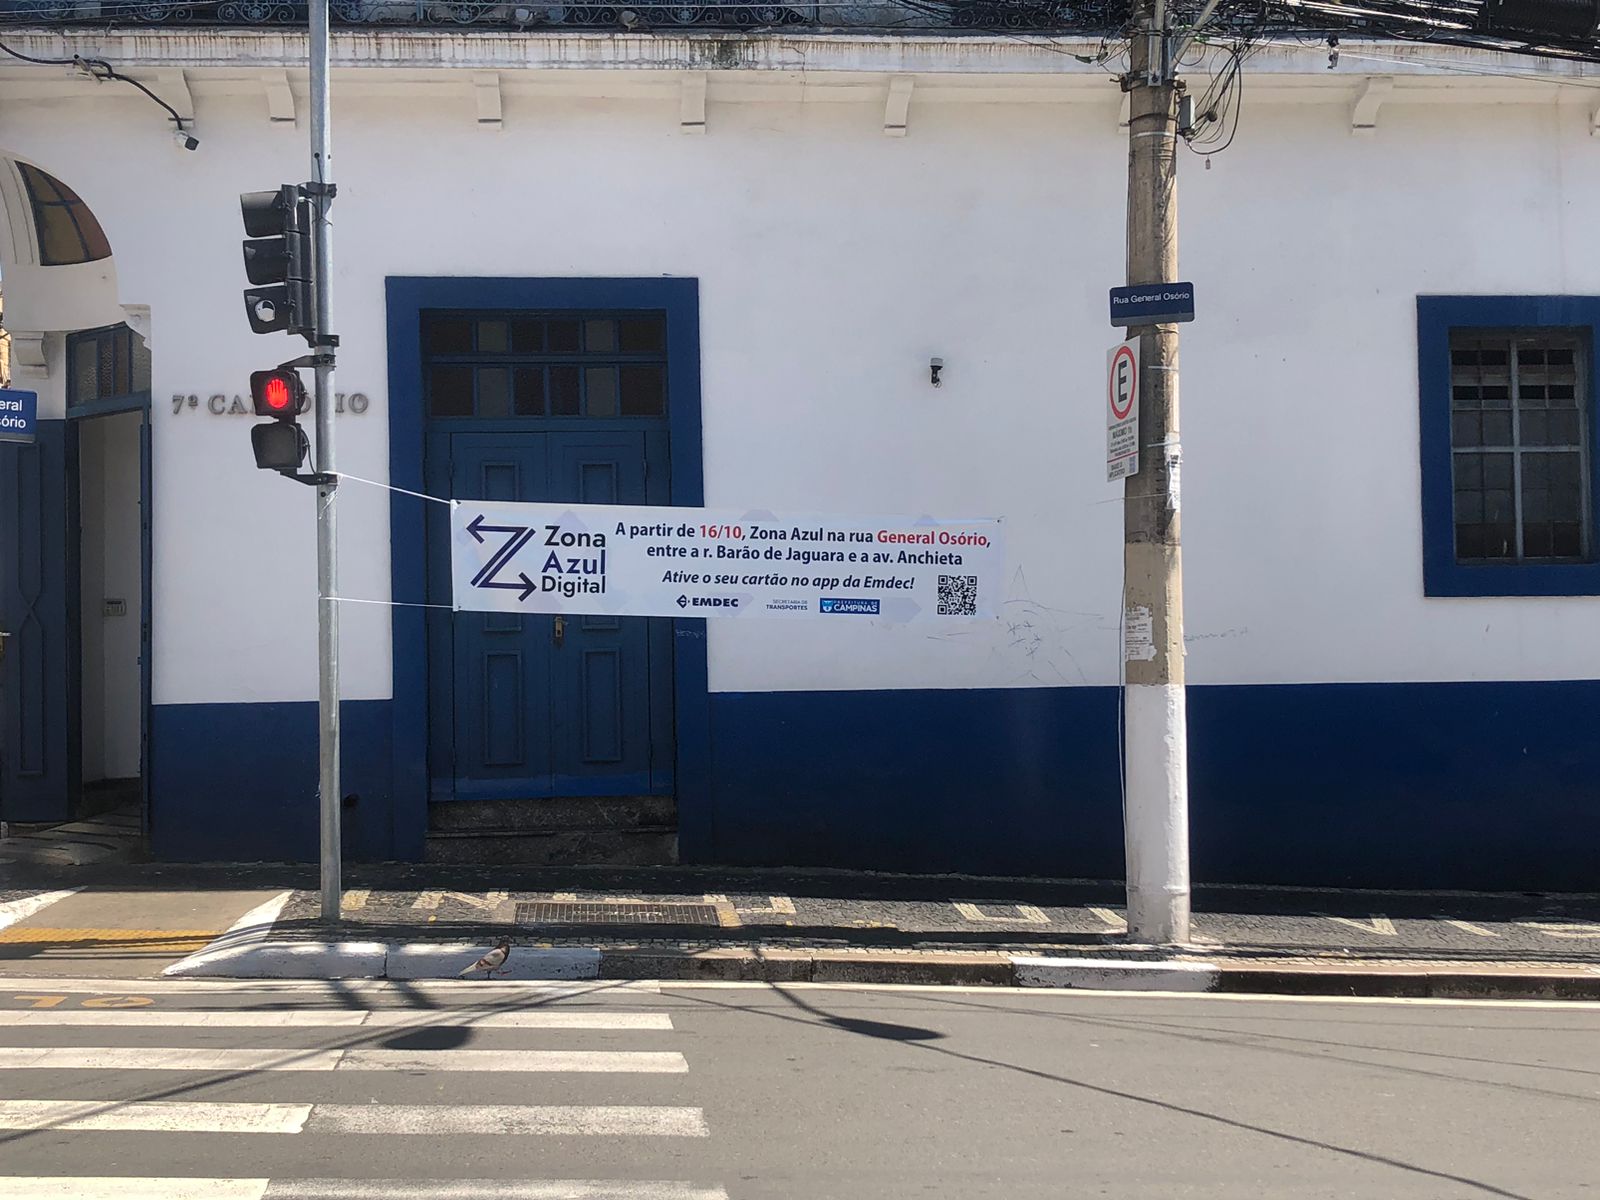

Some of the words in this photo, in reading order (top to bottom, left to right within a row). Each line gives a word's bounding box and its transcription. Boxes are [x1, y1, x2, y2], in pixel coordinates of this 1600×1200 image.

[1113, 296, 1129, 304] Rua
[1130, 294, 1161, 303] General
[1163, 291, 1190, 301] Osório
[1118, 360, 1127, 403] E
[207, 392, 369, 415] CAIO
[0, 415, 26, 429] ório
[544, 525, 606, 548] Zona
[615, 522, 626, 536] A
[630, 523, 673, 539] partir
[676, 523, 695, 538] de
[700, 525, 746, 541] 16/10,
[750, 526, 787, 540] Zona
[790, 527, 823, 542] Azul
[827, 530, 845, 542] na
[849, 531, 873, 543] rua
[877, 530, 935, 545] General
[939, 532, 991, 548] Osório,
[541, 550, 606, 574] Azul
[647, 545, 687, 558] entre
[690, 547, 699, 558] a
[703, 547, 713, 558] r.
[717, 545, 760, 560] Barão
[763, 546, 783, 560] de
[785, 547, 844, 564] Jaguara
[848, 552, 857, 562] e
[860, 552, 869, 562] a
[872, 552, 894, 564] av.
[897, 550, 963, 565] Anchieta
[541, 575, 606, 597] Digital
[662, 570, 699, 584] Ative
[702, 573, 711, 584] o
[714, 573, 739, 585] seu
[741, 572, 788, 586] cartão
[790, 576, 809, 587] no
[812, 576, 839, 590] app
[842, 575, 860, 588] da
[864, 575, 915, 590] Emdec!
[692, 597, 739, 608] EMDEC
[833, 603, 878, 612] CAMPINAS
